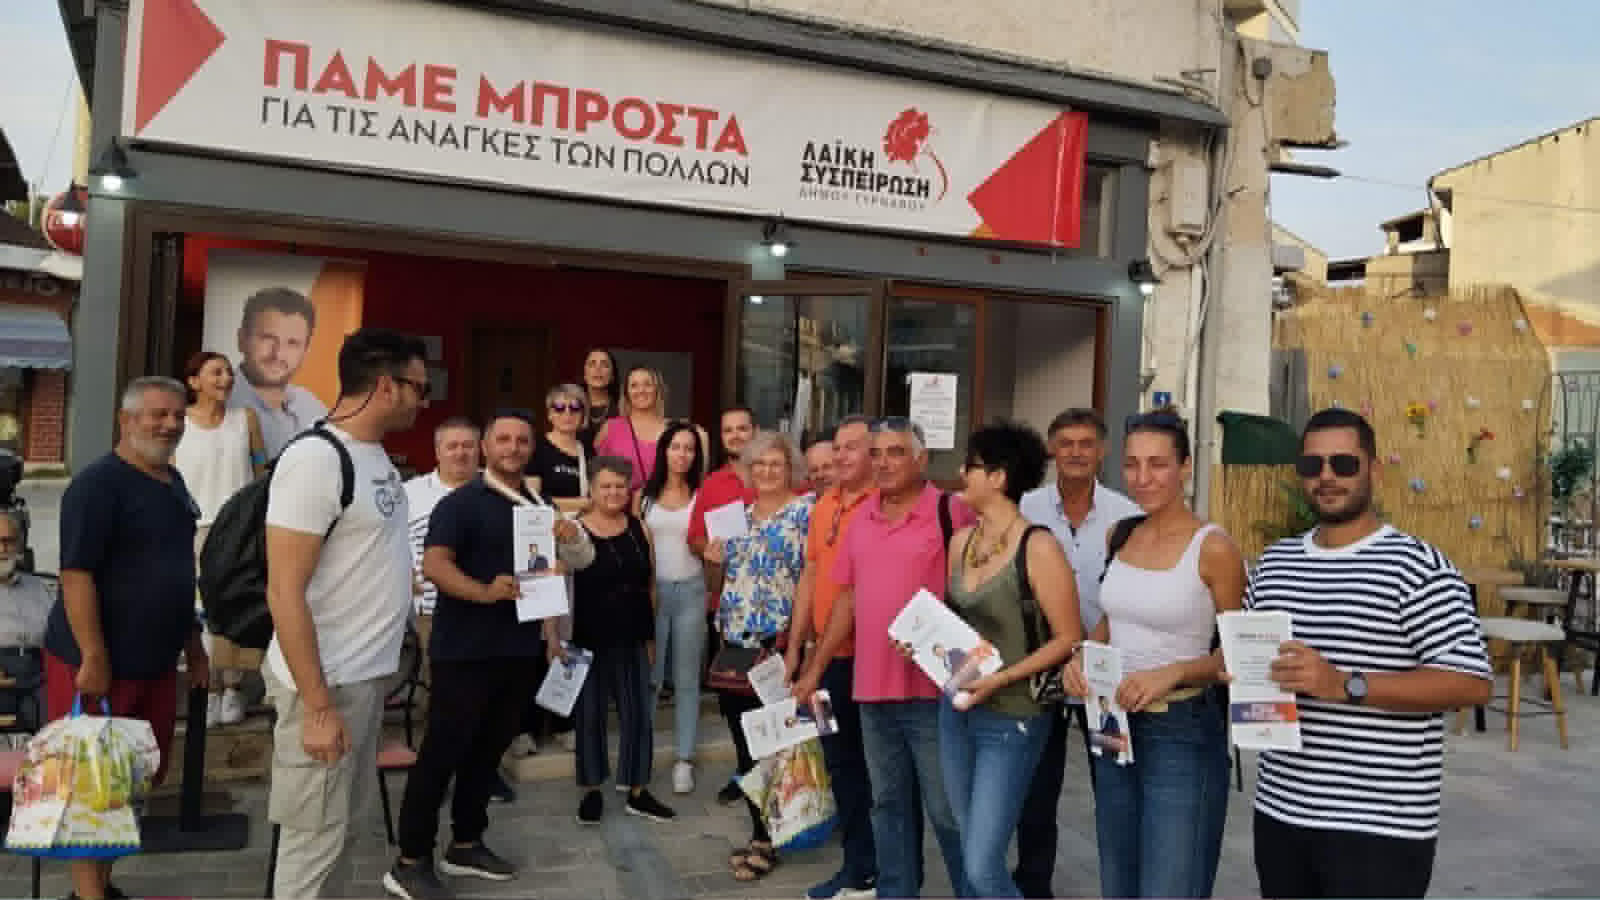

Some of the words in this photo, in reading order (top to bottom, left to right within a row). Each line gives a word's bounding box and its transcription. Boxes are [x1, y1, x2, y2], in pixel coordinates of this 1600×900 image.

[263, 38, 457, 112] ΠΑΜΕ
[476, 72, 750, 157] ΜΠΡΟΣΤΑ
[261, 96, 316, 129] ΓΙΑ
[326, 104, 380, 137] ΤΙΣ
[387, 115, 542, 161] ΑΝΑΓΚΕΣ
[550, 137, 616, 169] ΤΩΝ
[623, 148, 752, 188] ΠΟΛΛΩΝ
[802, 138, 875, 169] ΛΑΪΚΗ
[800, 163, 930, 198] ΣΥΣΠΕΙΡΩΣΗ
